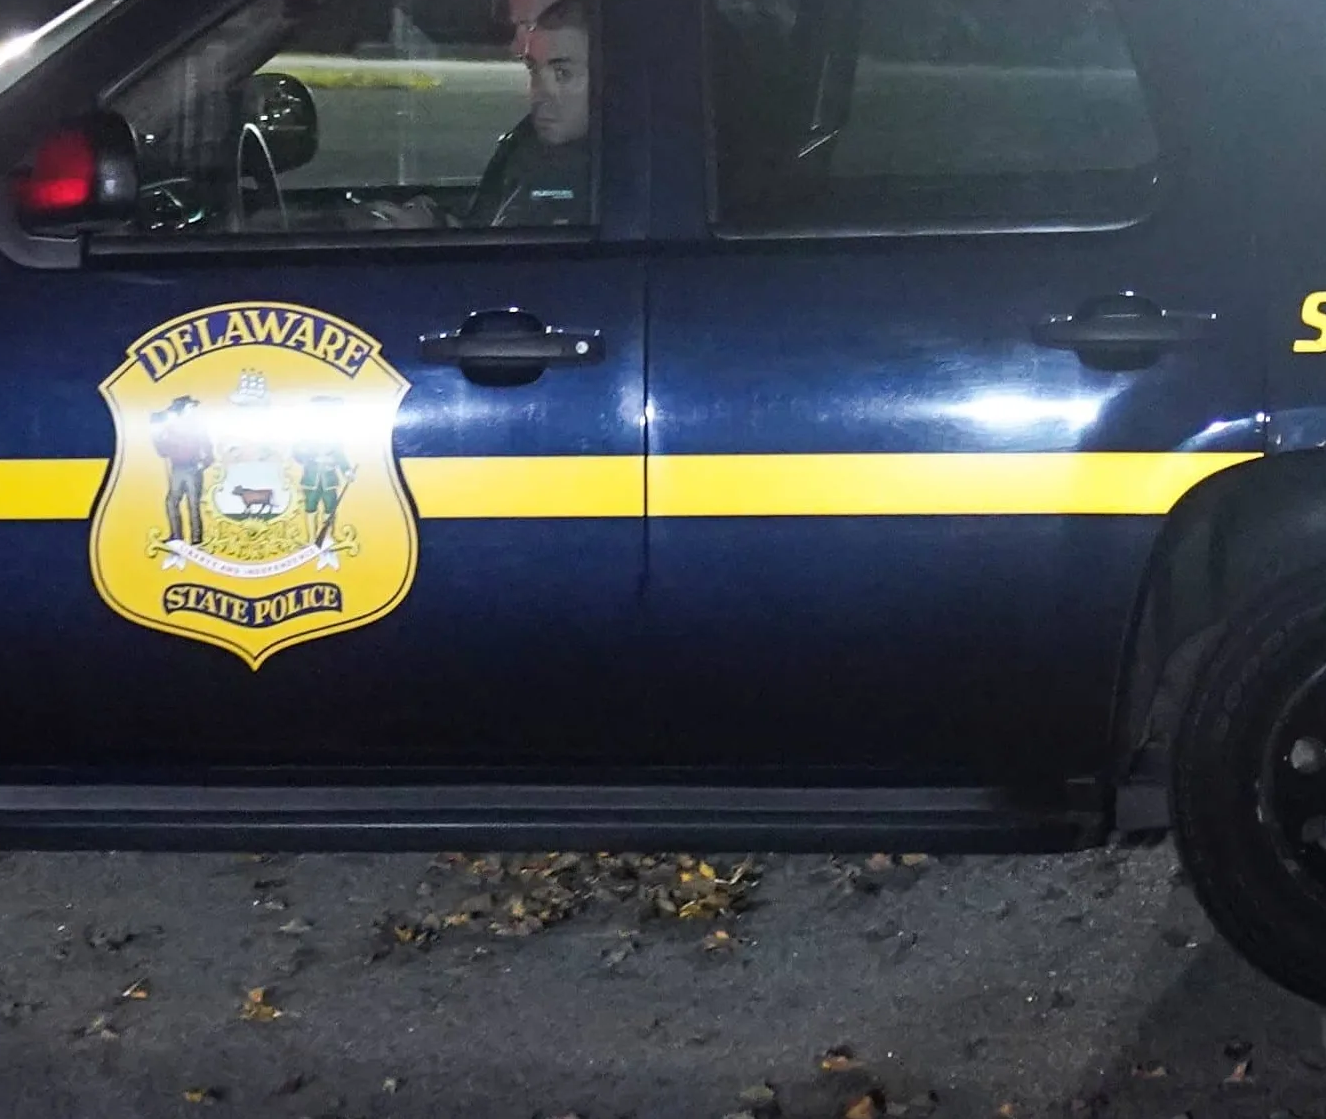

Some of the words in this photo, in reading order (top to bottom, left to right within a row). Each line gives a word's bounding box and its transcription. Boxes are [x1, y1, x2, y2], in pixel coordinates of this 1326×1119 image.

[140, 309, 371, 379] DELAWARE
[166, 585, 250, 624] STATE
[253, 584, 339, 626] POLICE
